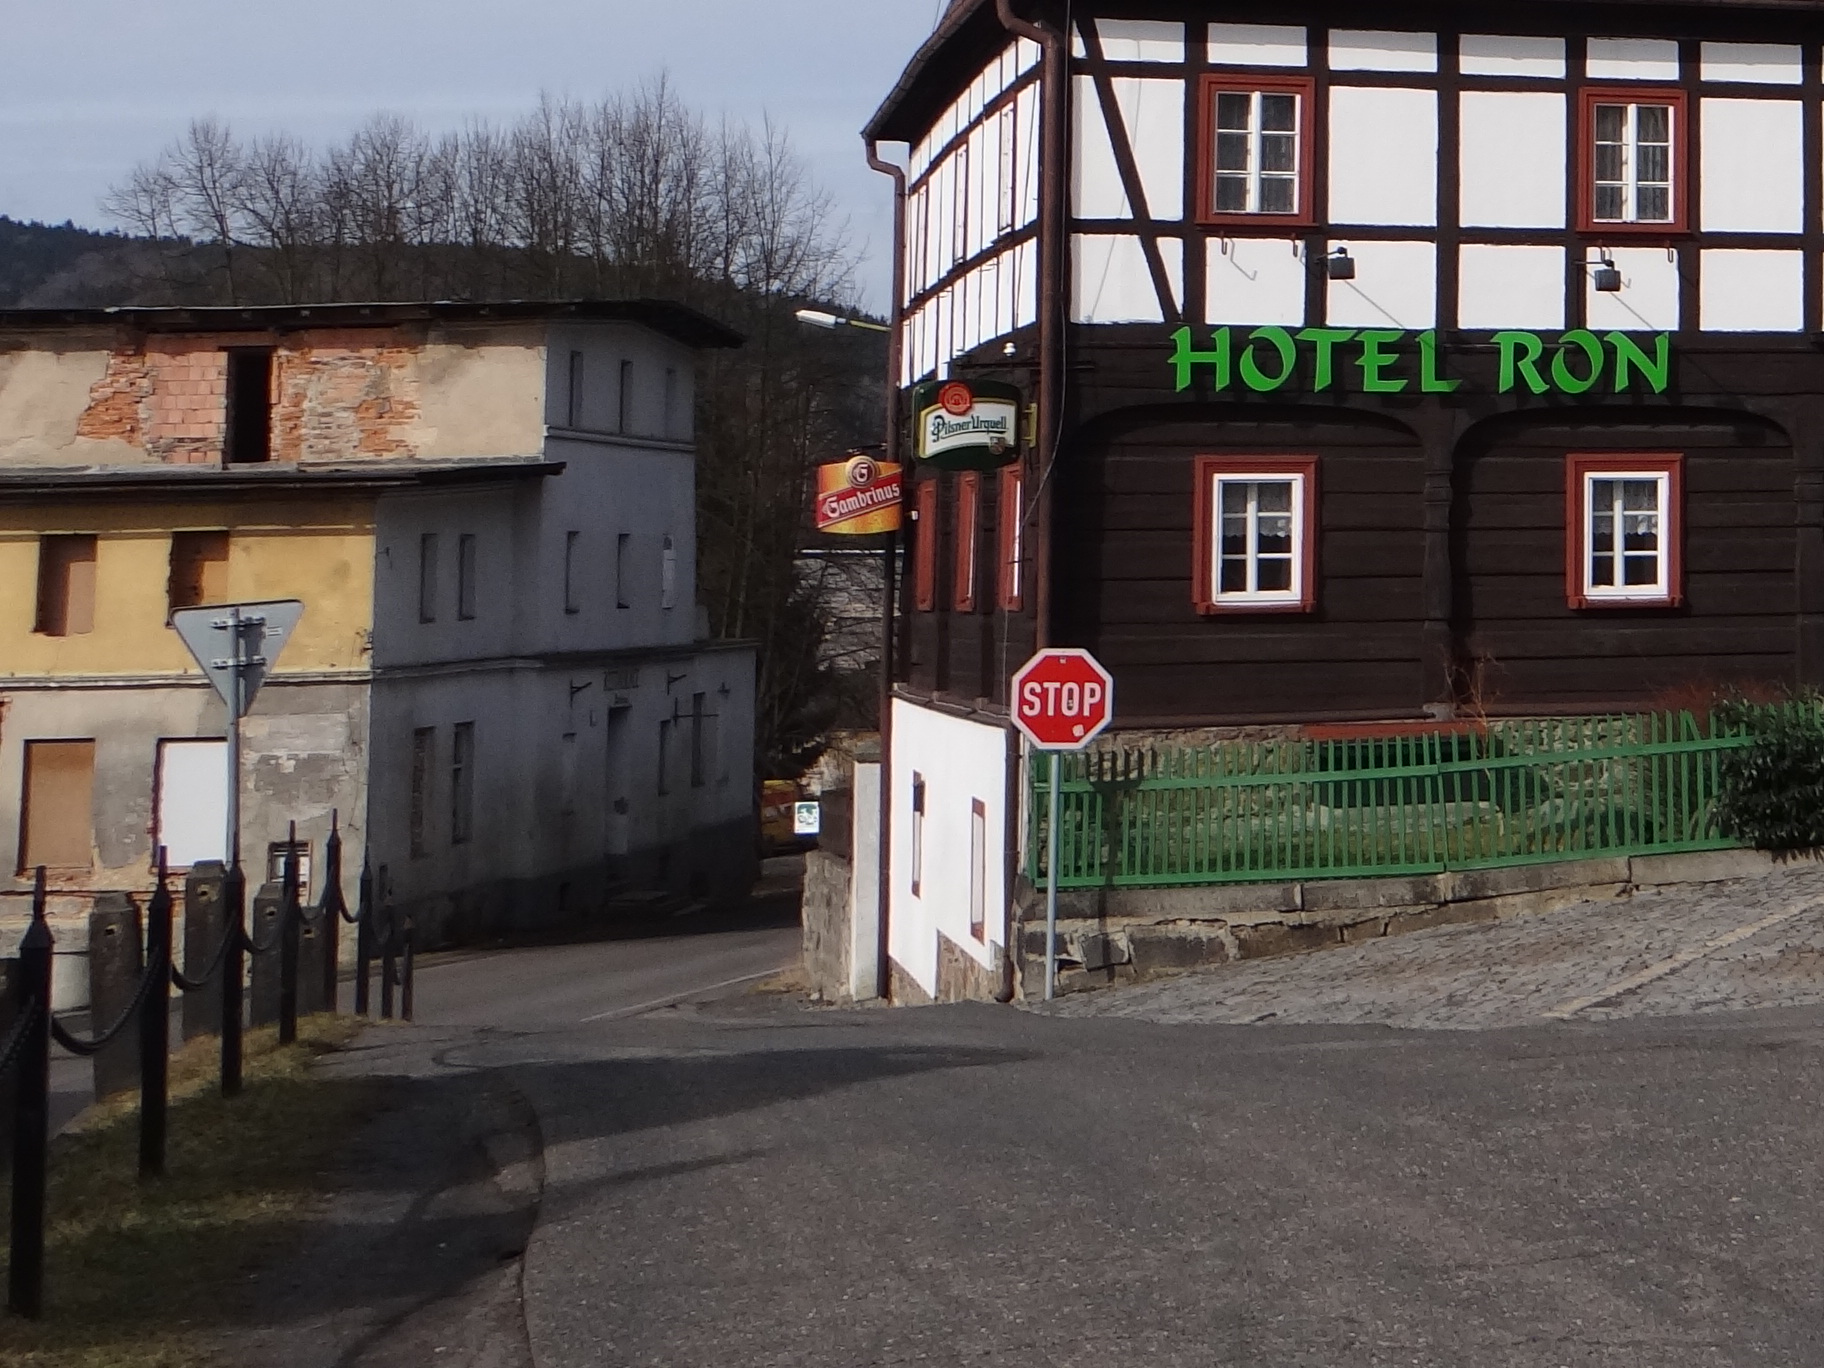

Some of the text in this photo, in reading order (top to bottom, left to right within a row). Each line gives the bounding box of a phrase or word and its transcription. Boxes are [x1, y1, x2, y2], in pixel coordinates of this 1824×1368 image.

[1167, 326, 1669, 394] HOTEL RON
[931, 414, 1007, 443] Pilsner Urquell
[822, 483, 900, 519] Gambrinus
[1022, 681, 1102, 717] STOP
